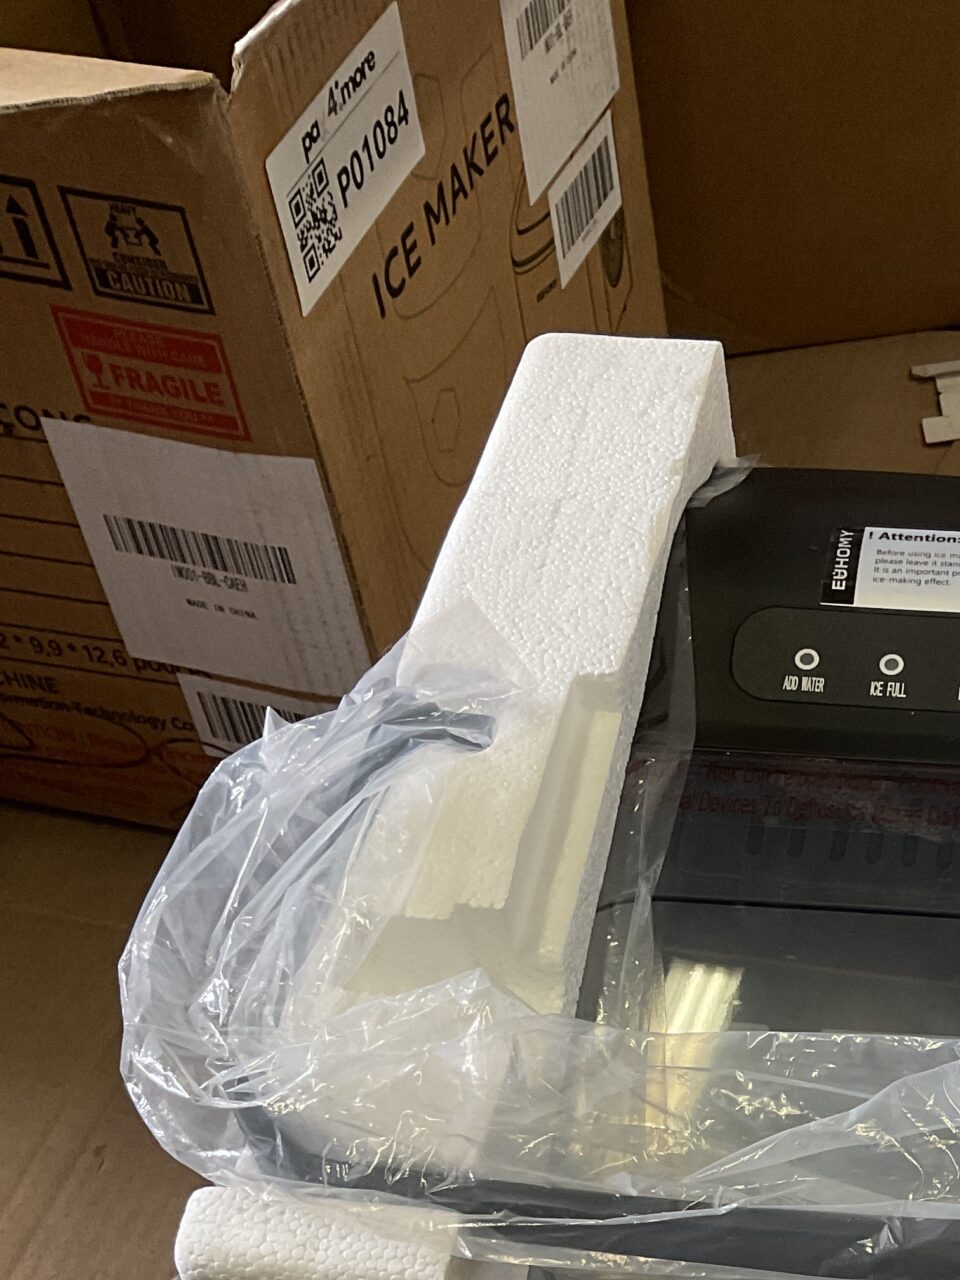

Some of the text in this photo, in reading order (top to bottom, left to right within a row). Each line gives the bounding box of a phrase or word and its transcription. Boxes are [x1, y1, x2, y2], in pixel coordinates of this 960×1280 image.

[301, 119, 320, 164] pa
[336, 89, 409, 209] P01084
[372, 92, 516, 320] ICE MAKER
[105, 269, 191, 303] CAUTION
[108, 361, 225, 406] FRAGILE
[875, 557, 904, 567] please
[905, 558, 930, 566] leave
[931, 559, 938, 567] it
[876, 548, 906, 557] Before
[907, 550, 932, 559] using
[934, 551, 947, 559] ice
[873, 566, 880, 574] It
[905, 567, 950, 577] important
[782, 675, 825, 693] ADD WATER
[870, 681, 907, 699] ICE FULL
